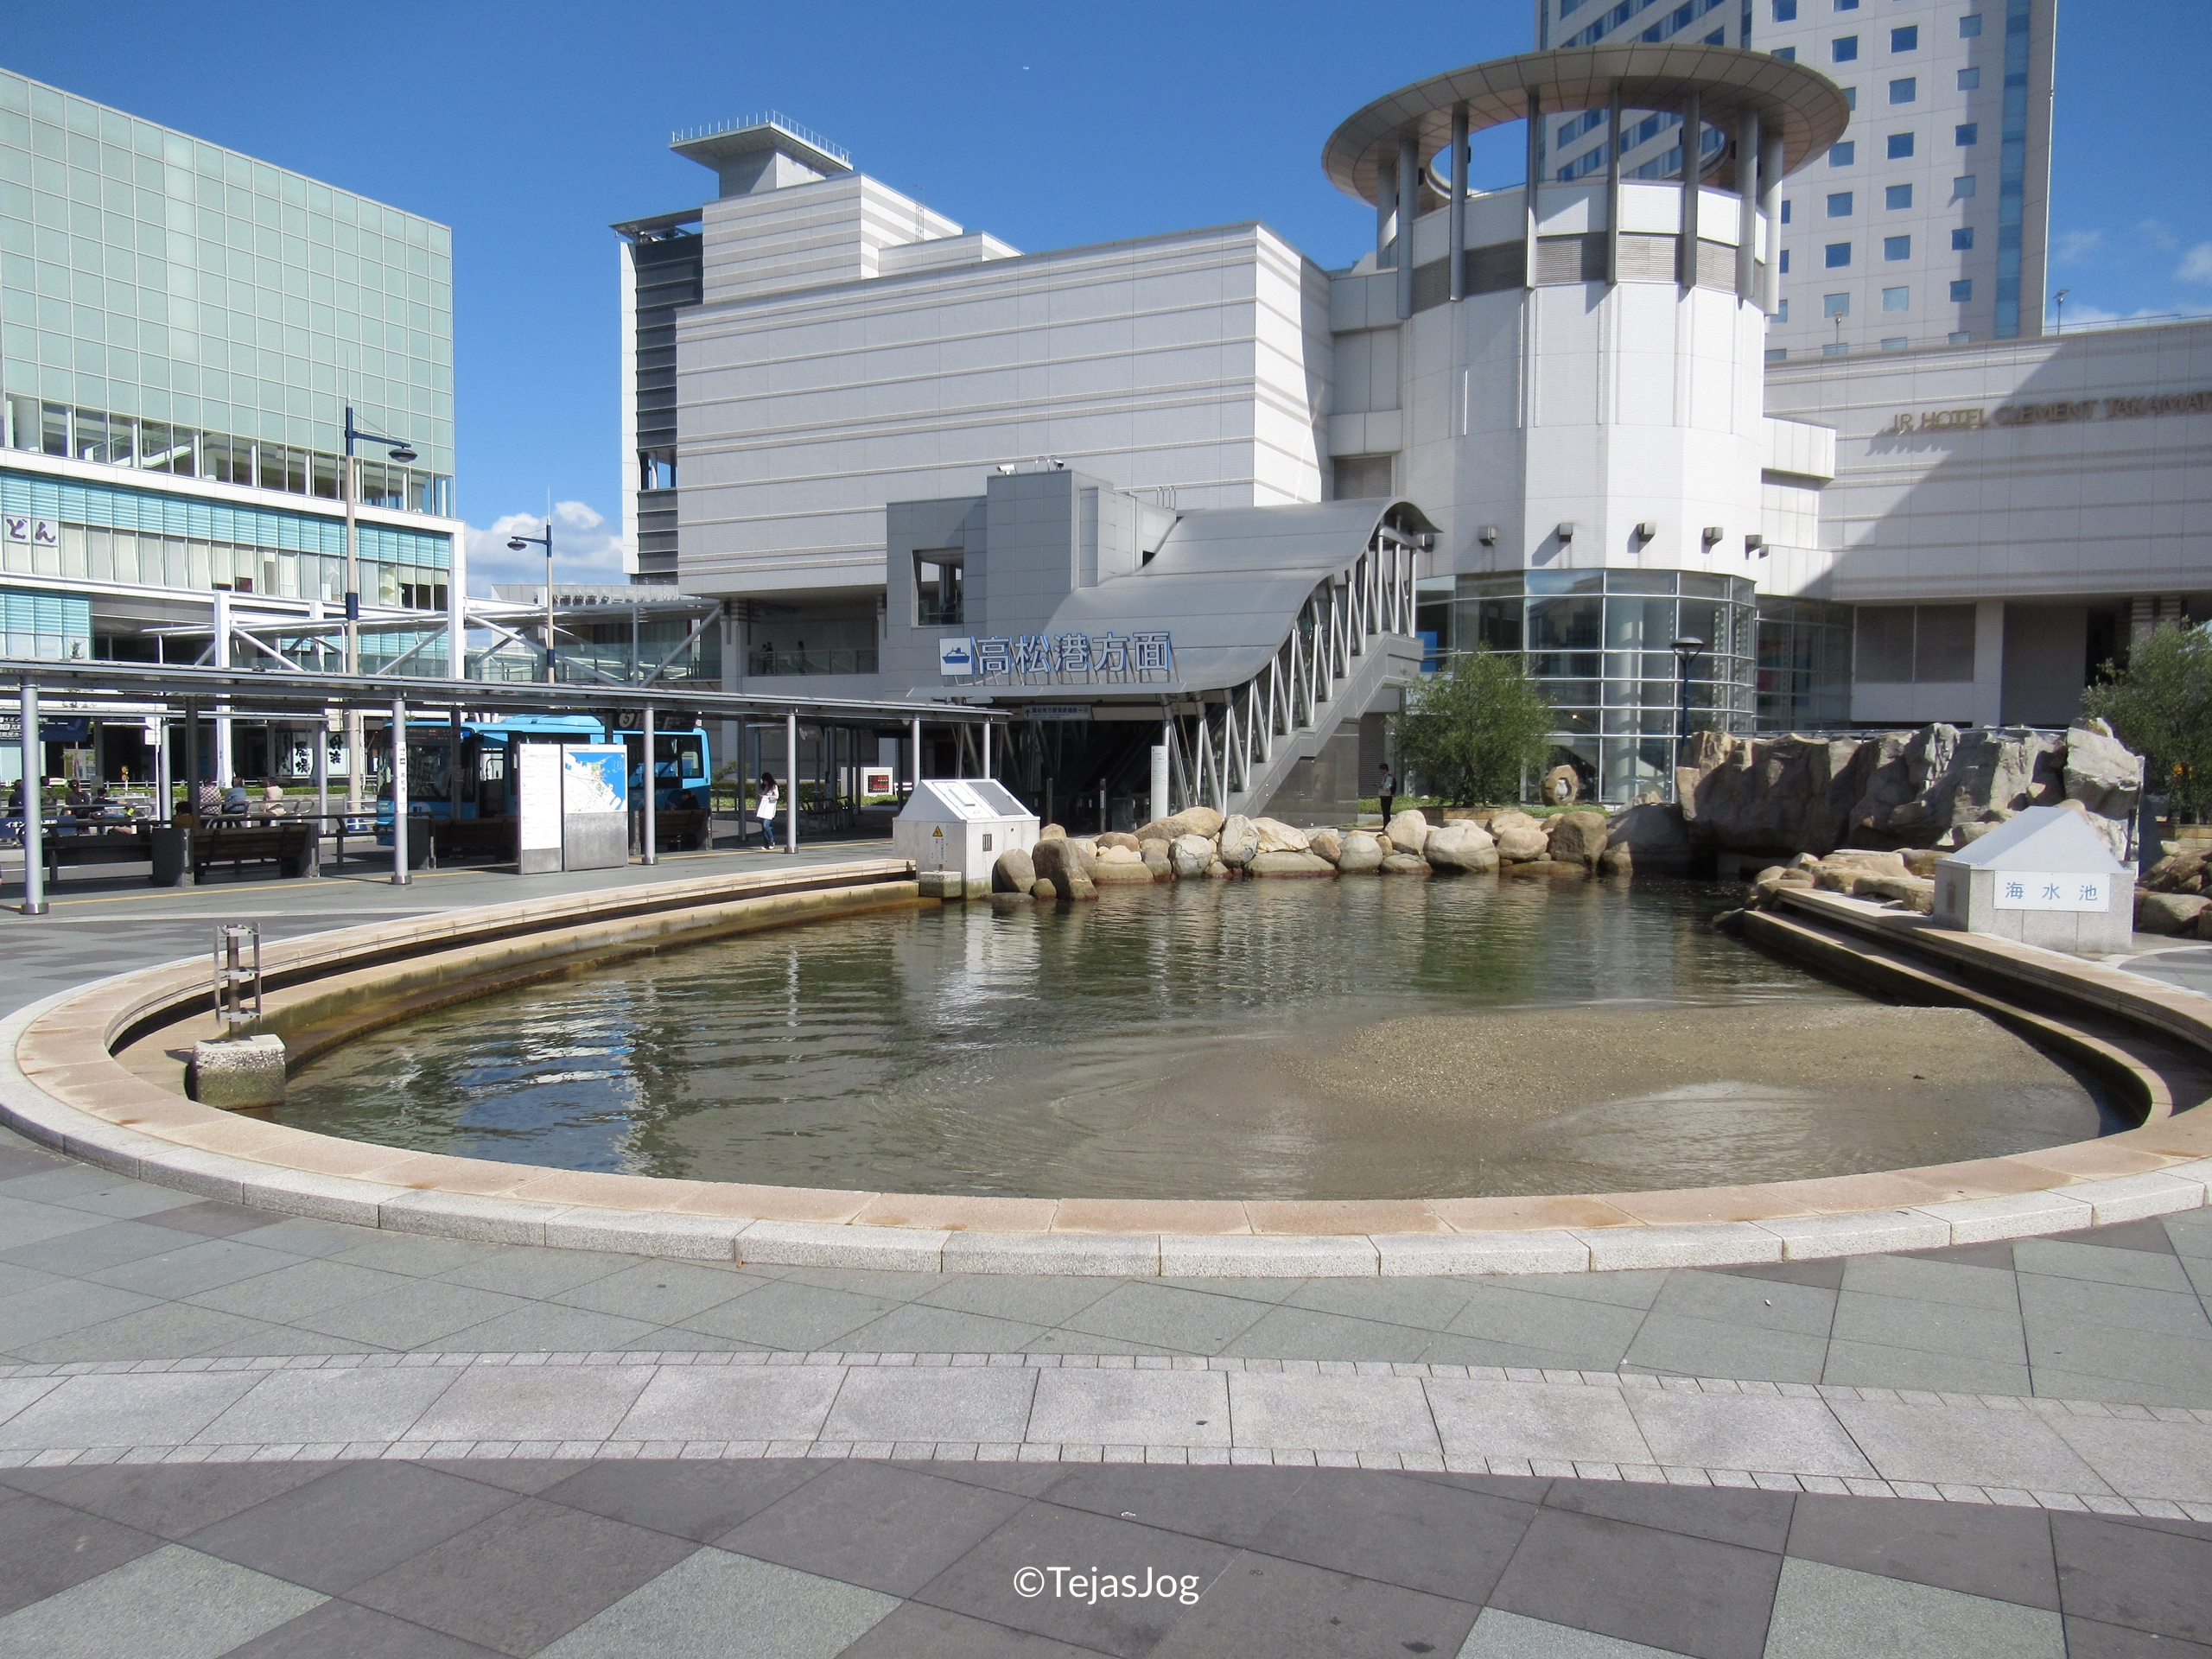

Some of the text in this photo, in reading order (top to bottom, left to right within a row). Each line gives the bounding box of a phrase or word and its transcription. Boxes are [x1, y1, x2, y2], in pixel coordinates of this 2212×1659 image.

[1891, 413, 1914, 433] JR
[1921, 408, 1988, 430] HOTEL
[1995, 398, 2098, 425] CLEMENT
[6, 518, 56, 543] どん
[976, 632, 1171, 675] 高松港方面
[2005, 881, 2098, 901] 海水池
